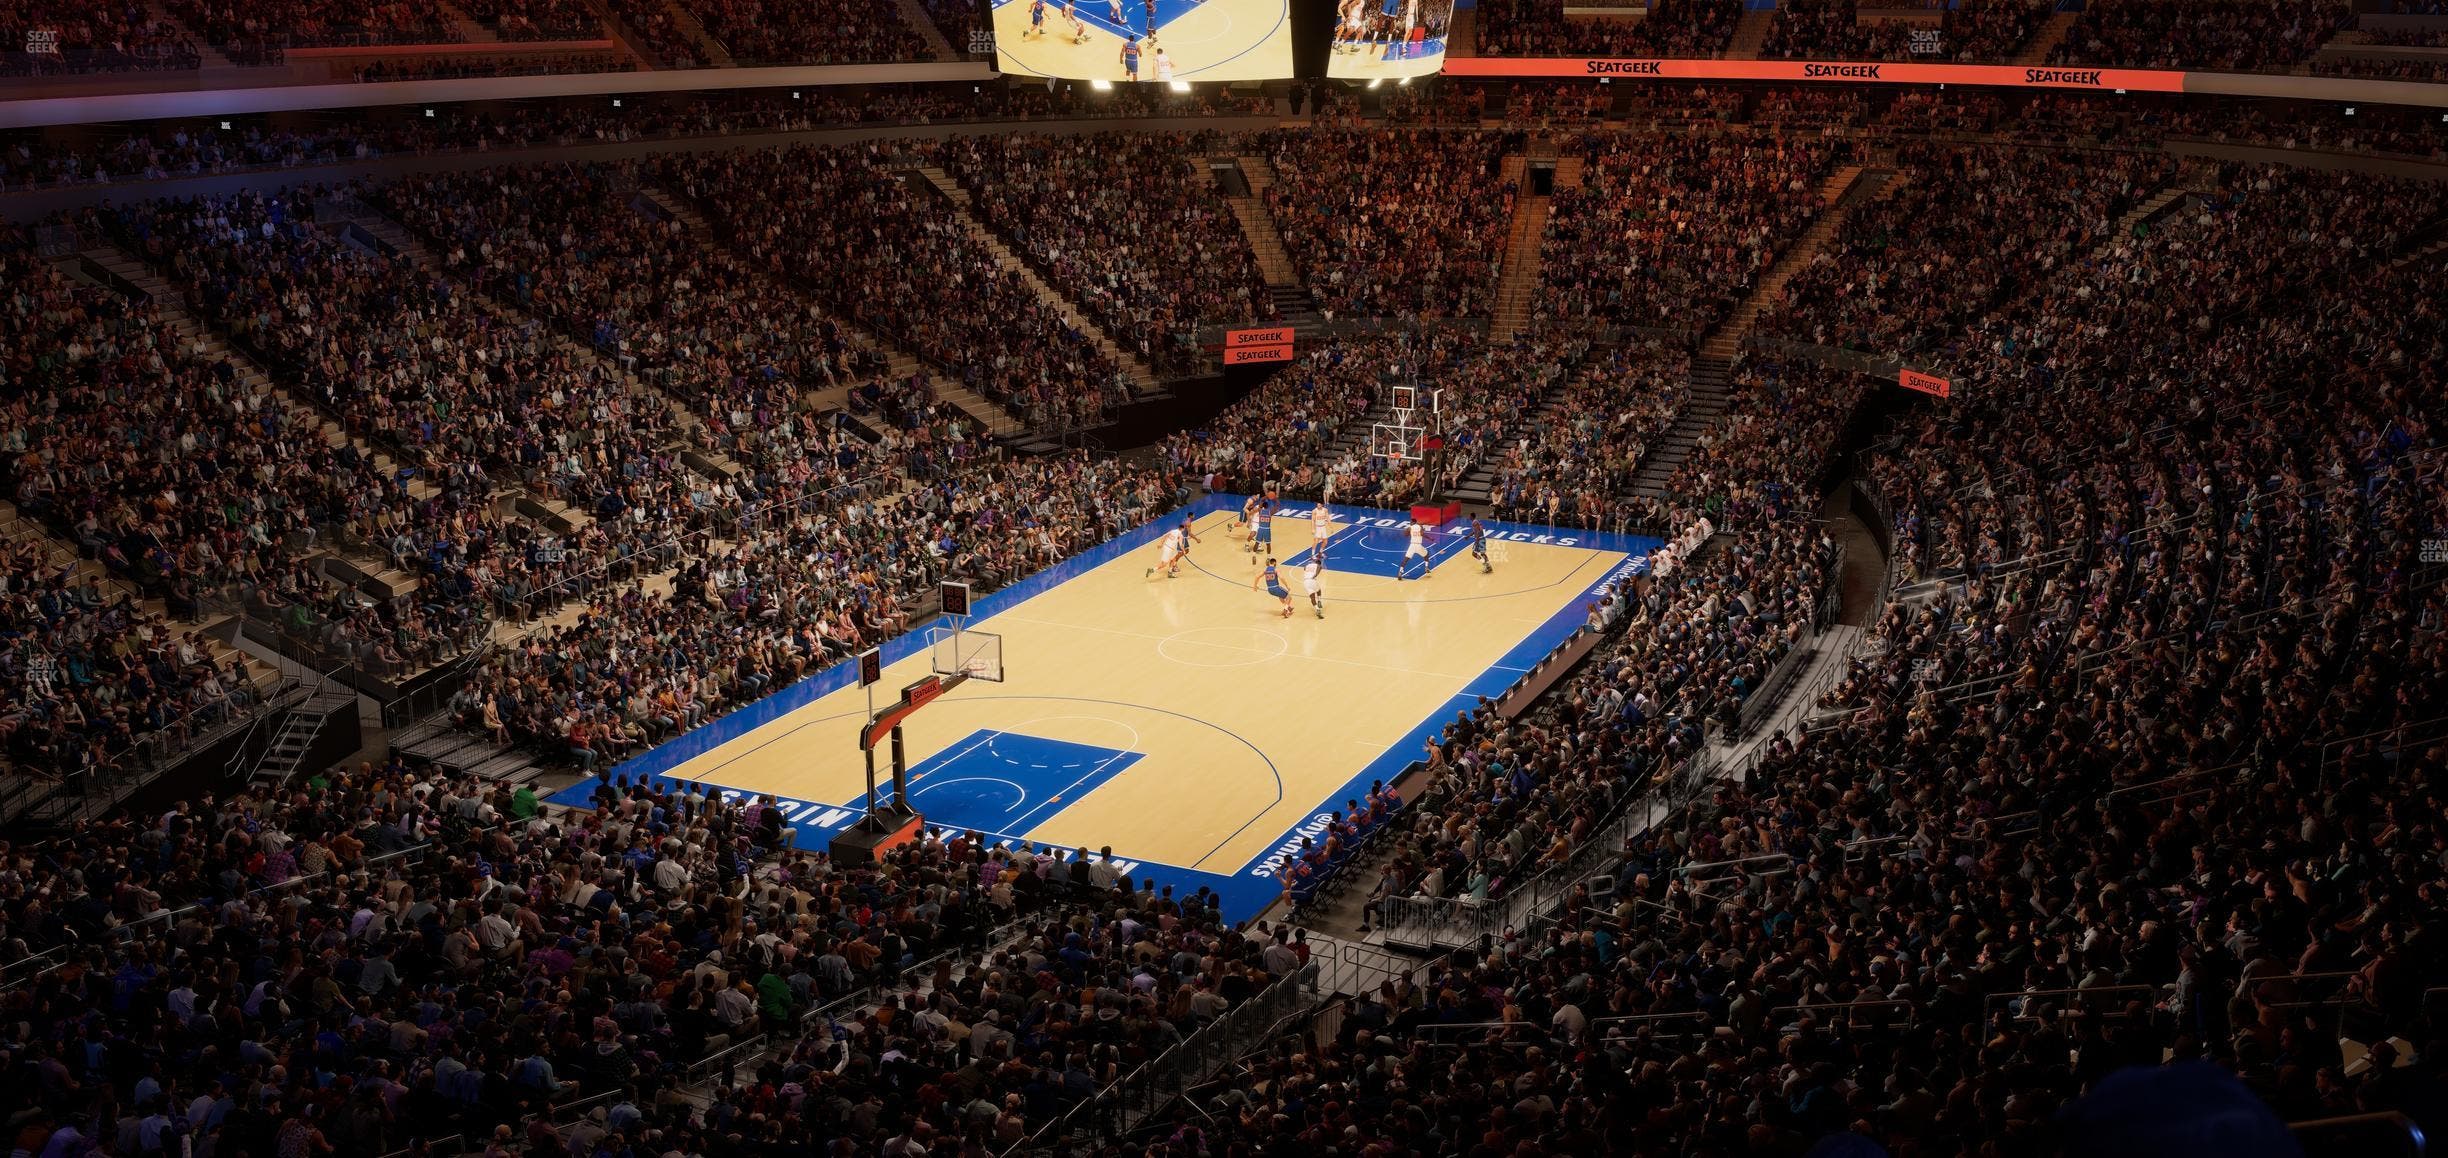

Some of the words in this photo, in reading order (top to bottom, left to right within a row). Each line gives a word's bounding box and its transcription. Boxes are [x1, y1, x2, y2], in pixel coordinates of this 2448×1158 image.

[1587, 60, 1661, 75] SEATGEEK
[1804, 64, 1880, 79] SEATGEEK
[2025, 69, 2100, 85] SEATGEEK
[1238, 332, 1282, 343] SEATGEEK
[1236, 350, 1281, 361] SEATGEEK
[1909, 375, 1942, 394] SEATGEEK
[914, 681, 937, 699] SEATGEEK
[1251, 812, 1334, 878] @nyknicks
